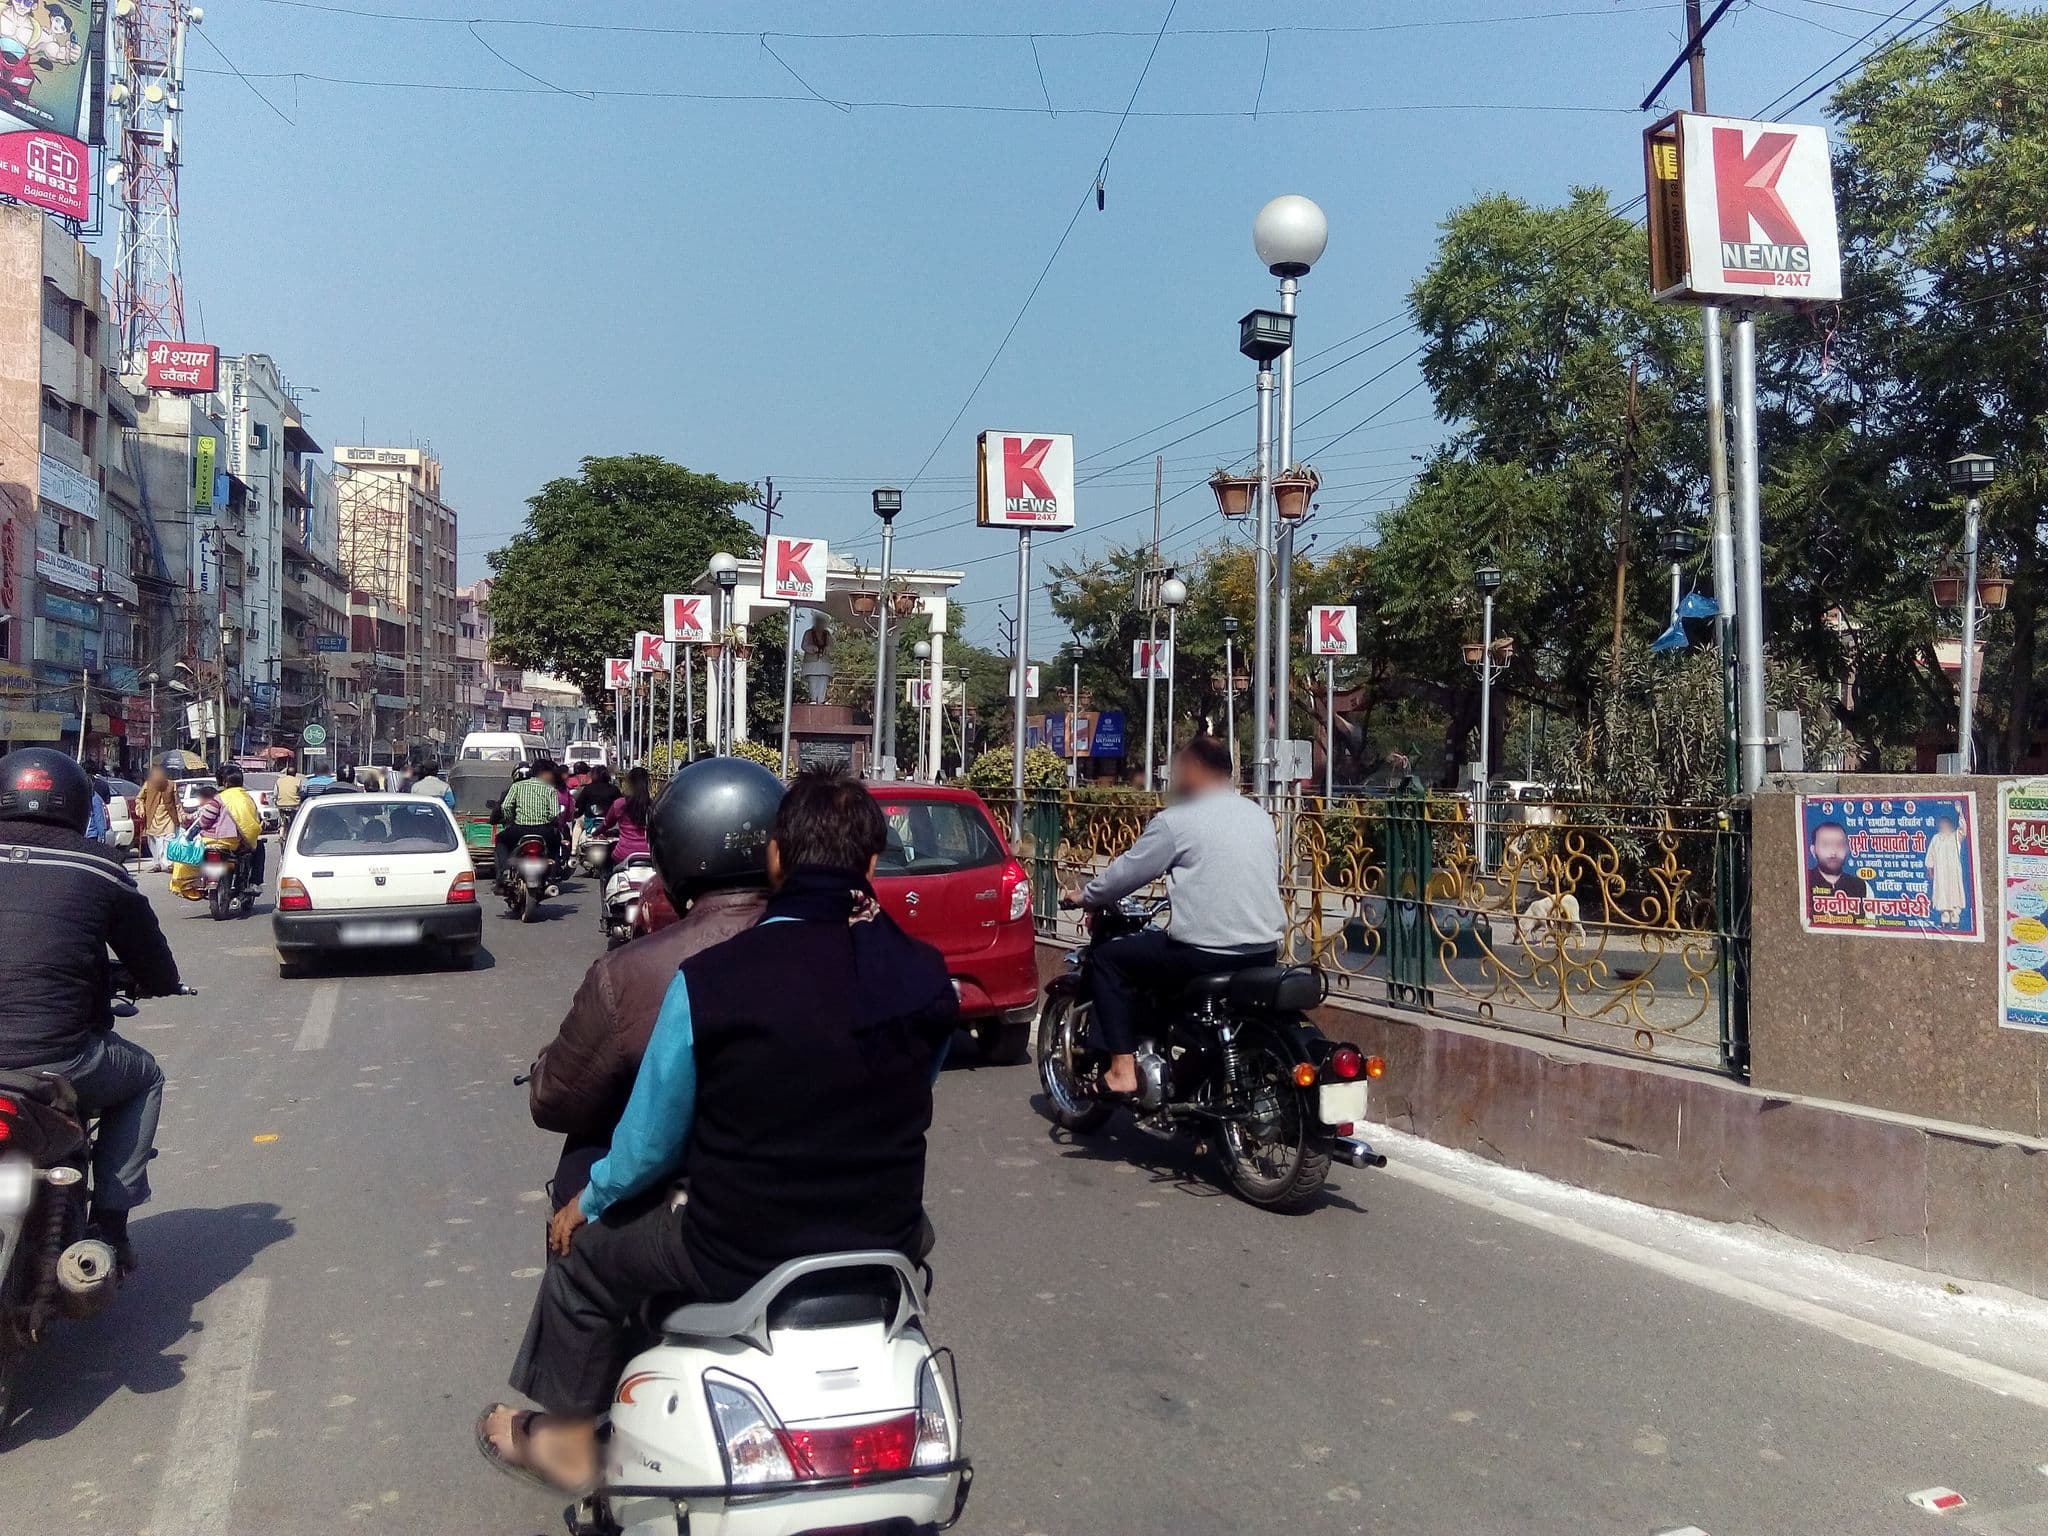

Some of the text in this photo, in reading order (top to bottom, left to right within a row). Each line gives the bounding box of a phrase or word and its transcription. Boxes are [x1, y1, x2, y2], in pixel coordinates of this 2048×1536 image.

[11, 164, 20, 175] IN
[29, 143, 78, 181] RED
[27, 170, 78, 195] FM 93.5
[1712, 127, 1808, 246] K
[24, 185, 82, 209] Bajaate Raho!
[1723, 244, 1810, 272] NEWS
[1776, 273, 1811, 287] 24X7
[151, 344, 210, 367] श्री श्याम
[1003, 437, 1056, 499] K
[1006, 498, 1056, 512] NEWS
[1036, 513, 1057, 521] 24X7
[777, 540, 813, 584] K
[777, 581, 813, 593] NEWS
[674, 599, 703, 630] K
[1320, 610, 1347, 642] K
[316, 637, 343, 646] GEET
[675, 628, 703, 637] NEWS
[642, 636, 665, 662] K
[1321, 641, 1347, 649] NEWS
[611, 660, 629, 681] K
[1870, 830, 1910, 853] मायावती
[1911, 830, 1927, 853] जी
[1860, 869, 1873, 878] 60
[1915, 871, 1925, 879] पर
[1875, 879, 1929, 893] हार्दिक बधाई
[1813, 890, 1930, 918] मनीष बाजपेयी
